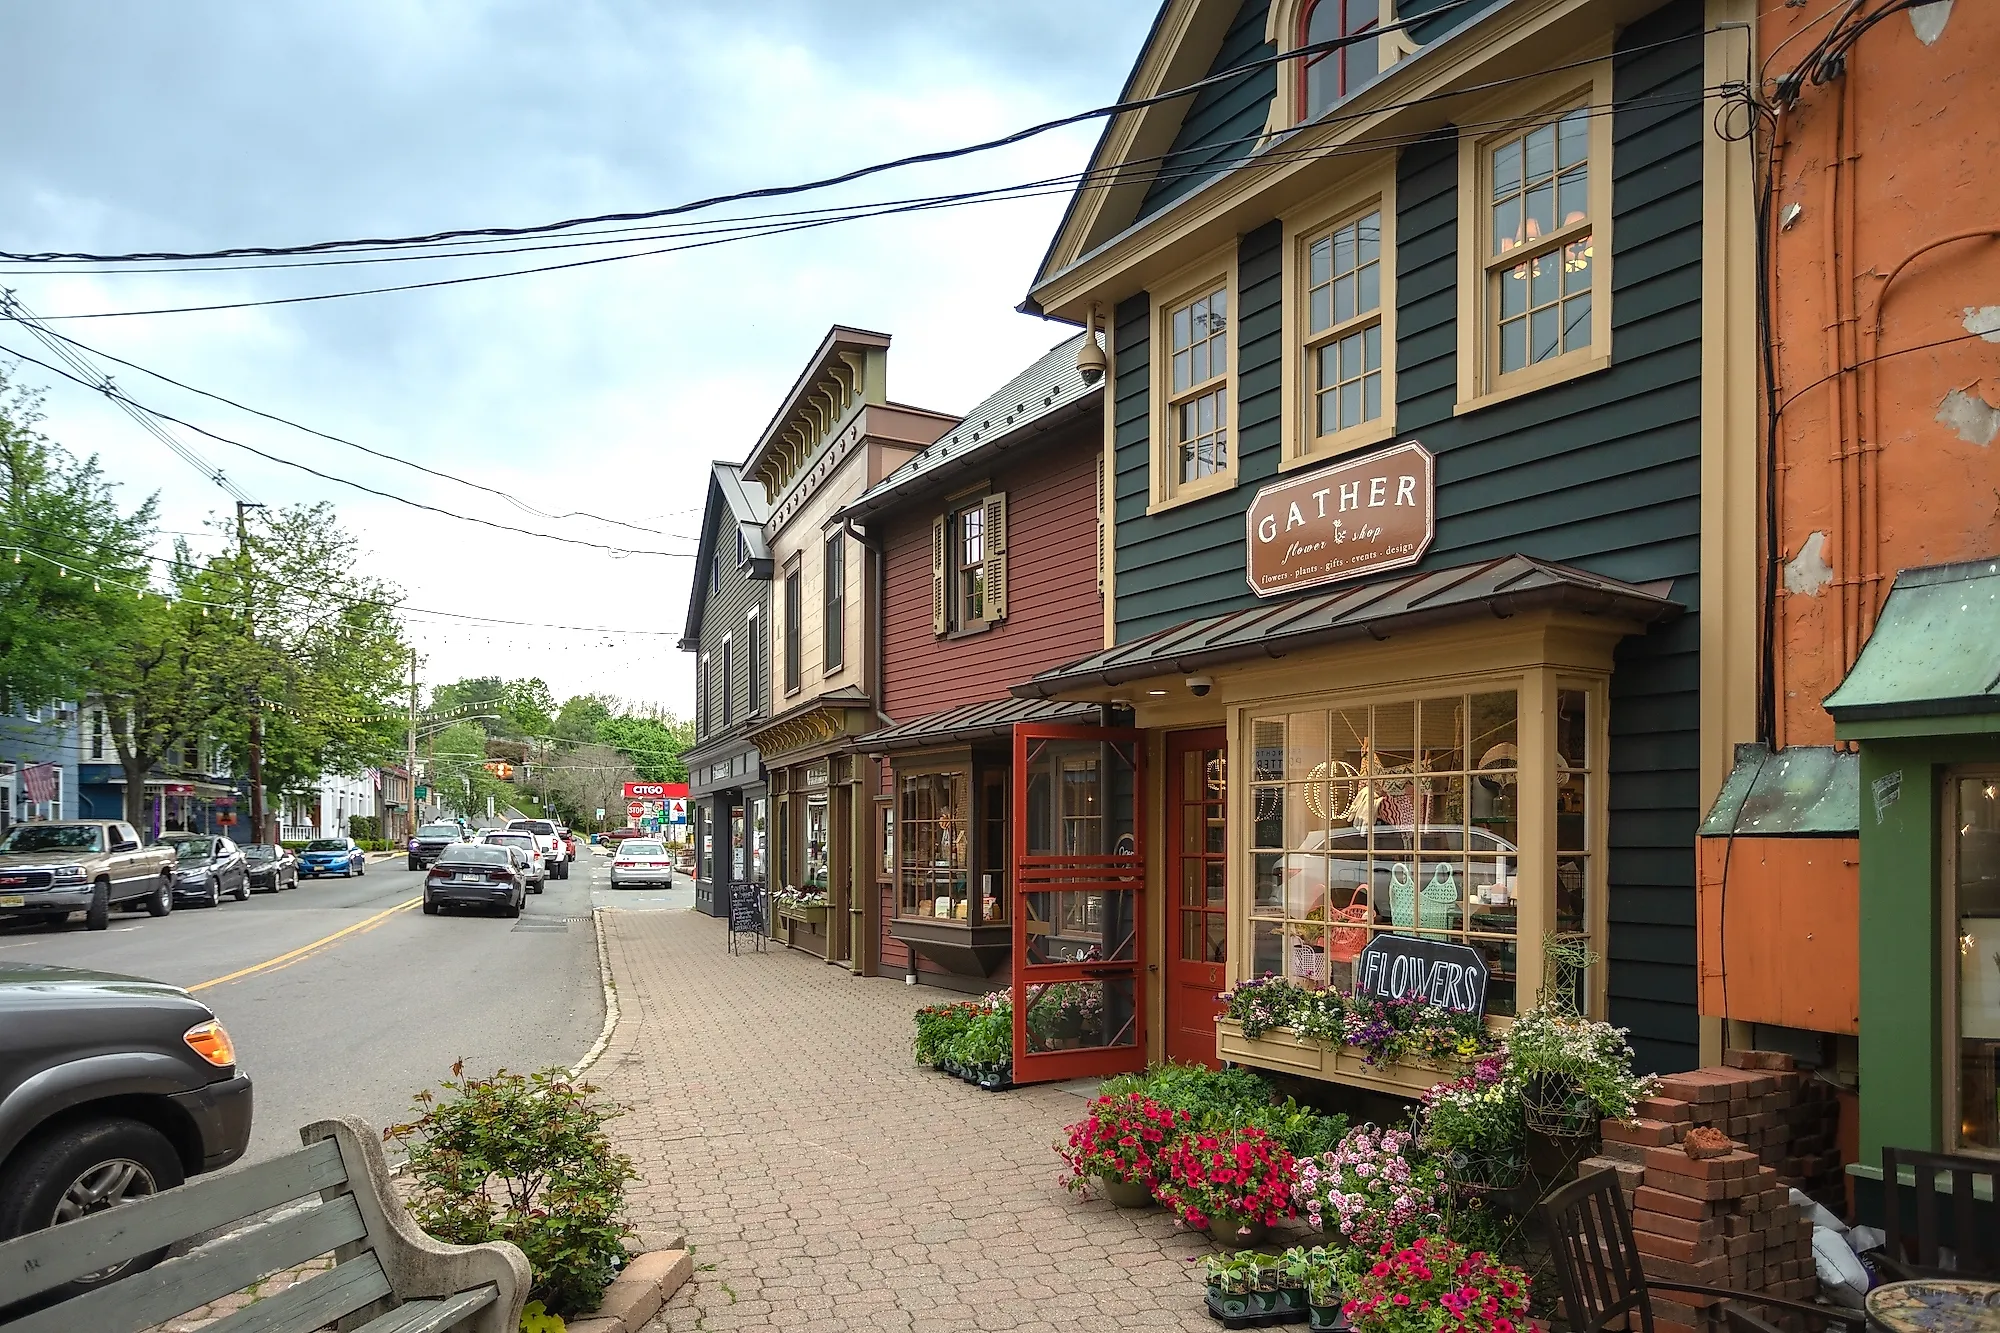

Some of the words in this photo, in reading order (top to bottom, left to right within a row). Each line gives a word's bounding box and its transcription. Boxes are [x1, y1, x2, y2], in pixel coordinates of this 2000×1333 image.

[1258, 475, 1416, 543] GATHER
[1261, 571, 1288, 585] flowers
[1295, 565, 1318, 579] plants
[1325, 558, 1343, 572] gifts
[1351, 551, 1377, 564] events
[1386, 542, 1413, 556] design
[1281, 540, 1327, 566] flower
[1351, 524, 1382, 544] shop
[633, 785, 663, 794] CITGO
[1364, 950, 1477, 1012] FLOWERS
